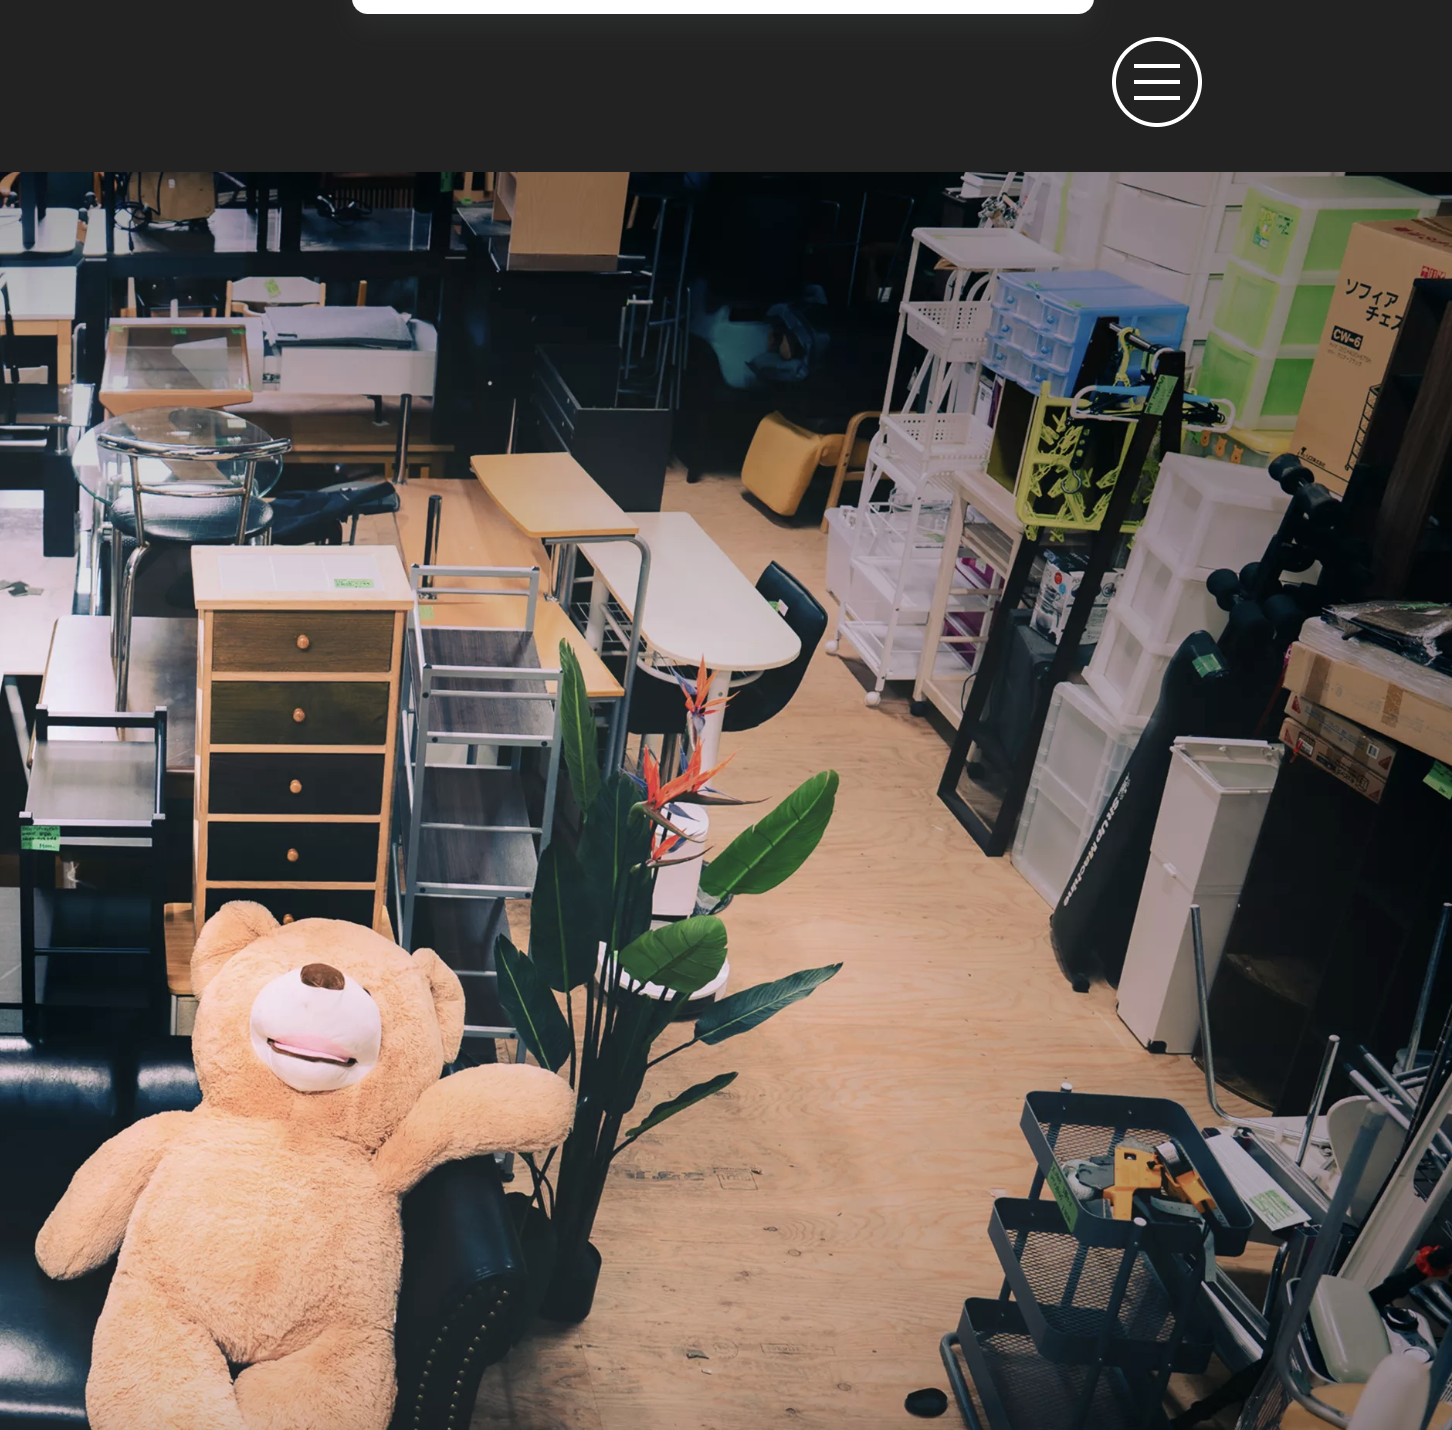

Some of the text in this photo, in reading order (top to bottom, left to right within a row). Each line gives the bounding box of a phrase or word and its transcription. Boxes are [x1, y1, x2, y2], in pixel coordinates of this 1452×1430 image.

[1345, 278, 1399, 308] ソフィア
[1333, 327, 1362, 348] CW-6
[1063, 796, 1120, 907] Sit Up Machine
